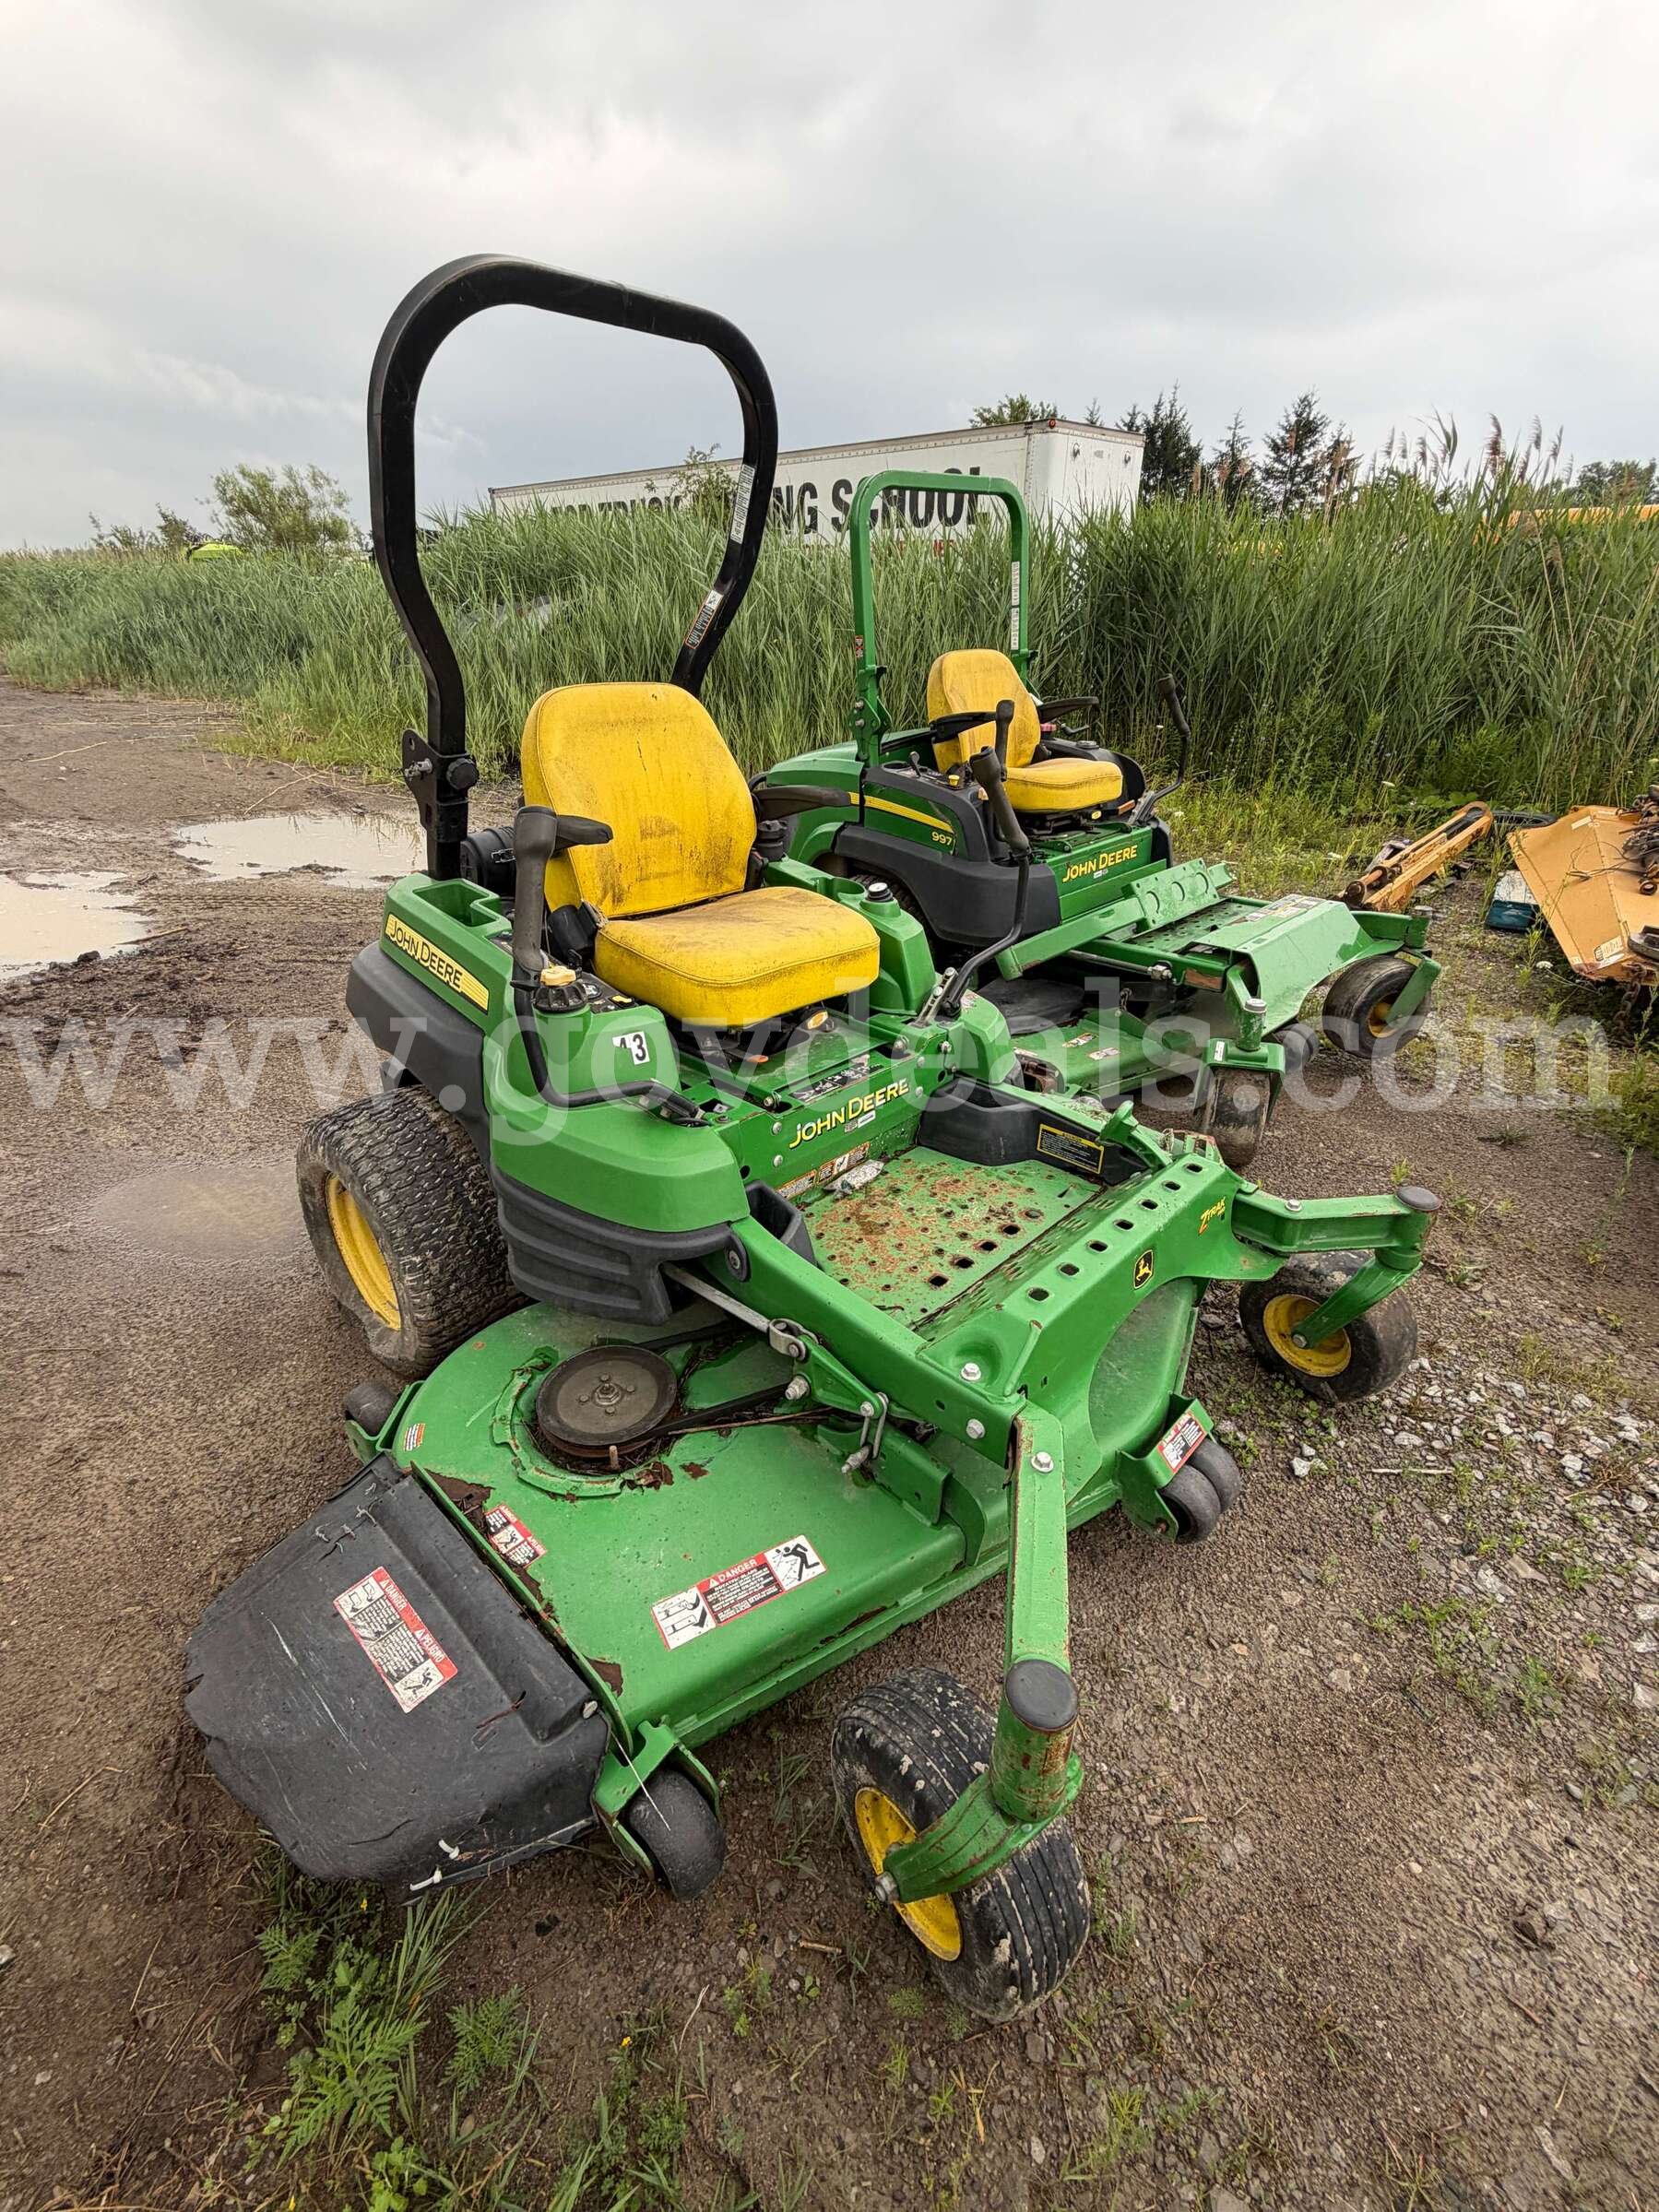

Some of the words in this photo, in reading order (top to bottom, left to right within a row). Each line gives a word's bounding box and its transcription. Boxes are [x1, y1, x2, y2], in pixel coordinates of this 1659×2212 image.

[831, 466, 990, 533] SHOOL
[931, 831, 953, 846] 997
[1062, 858, 1097, 882] JOHN
[1098, 845, 1138, 869] DEERE
[390, 920, 420, 957] JOHN
[420, 942, 463, 989] DEERE
[789, 1106, 847, 1149] JOHN
[847, 1077, 910, 1120] DEERE
[718, 1558, 757, 1582] DANGER
[386, 1586, 408, 1611] DANGER
[419, 1633, 445, 1662] PELIGRO
